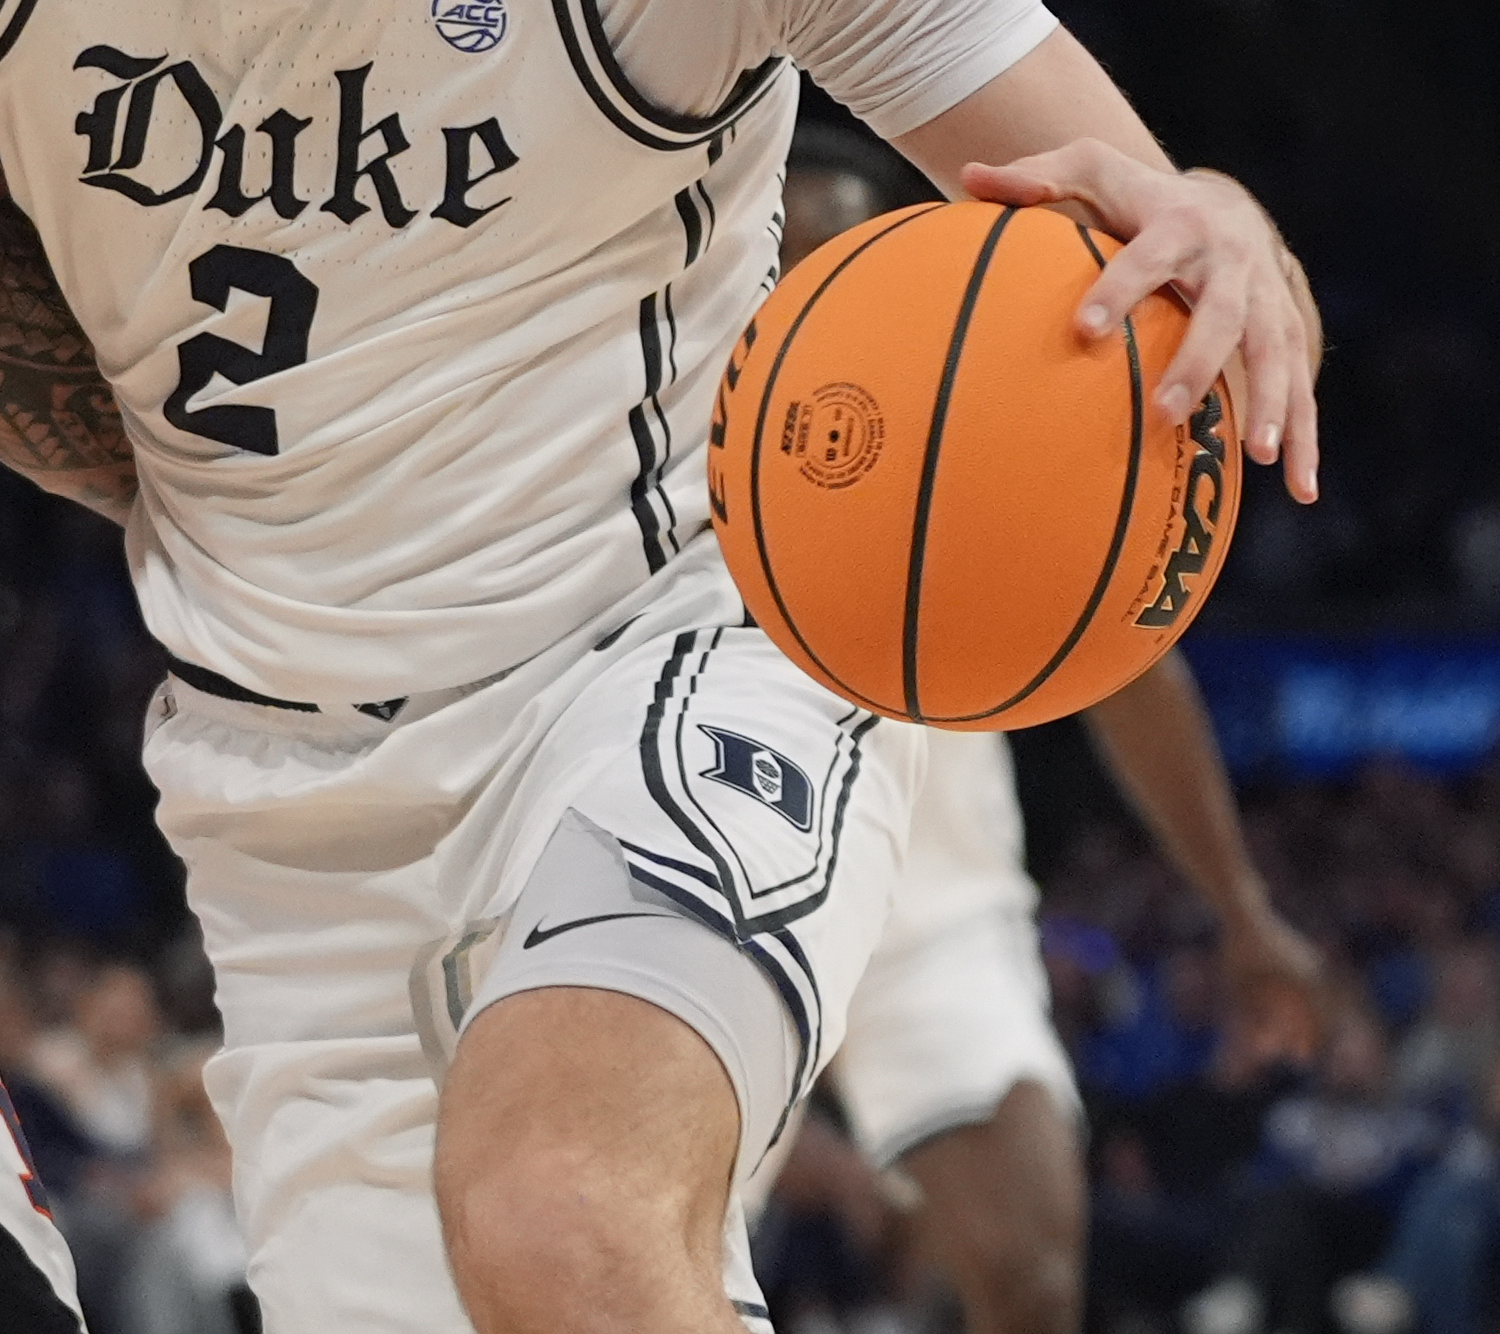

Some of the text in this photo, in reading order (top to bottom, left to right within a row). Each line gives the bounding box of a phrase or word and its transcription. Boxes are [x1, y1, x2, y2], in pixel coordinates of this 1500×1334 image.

[441, 4, 503, 23] ACC
[73, 44, 520, 229] Duke
[163, 244, 320, 457] 2
[1131, 389, 1226, 629] NCAA
